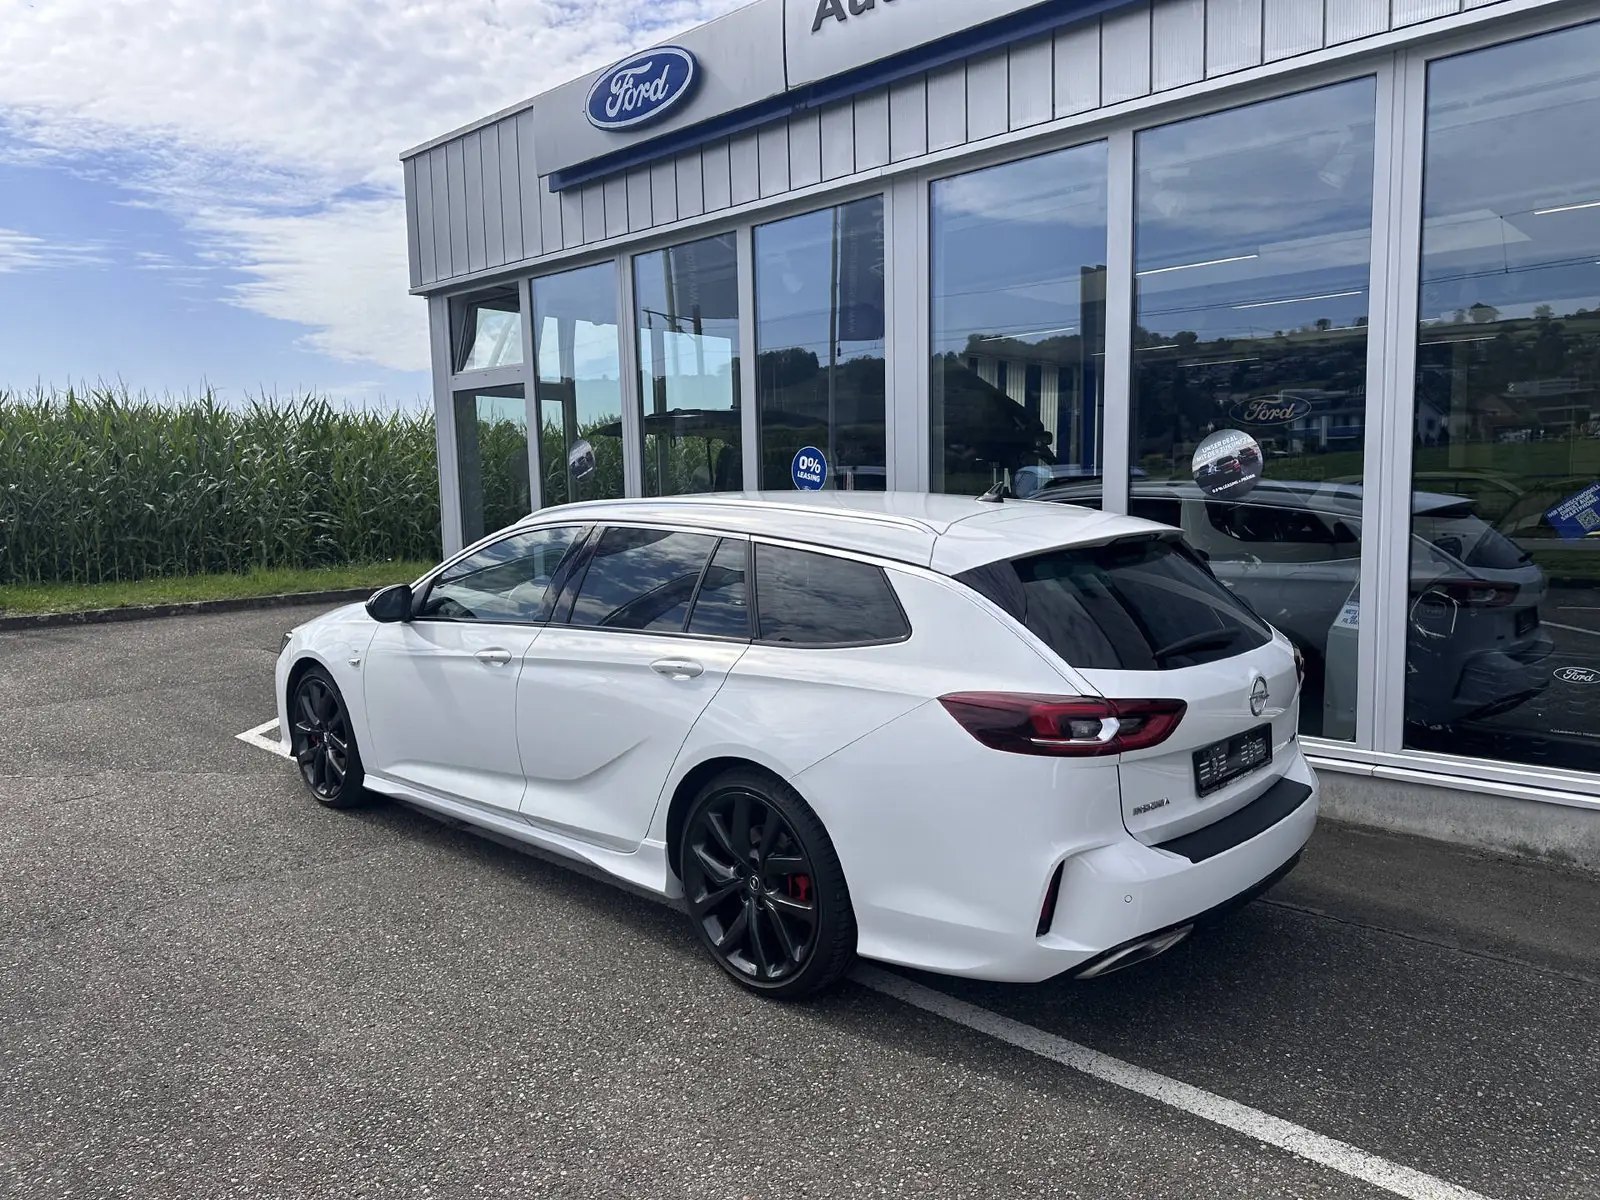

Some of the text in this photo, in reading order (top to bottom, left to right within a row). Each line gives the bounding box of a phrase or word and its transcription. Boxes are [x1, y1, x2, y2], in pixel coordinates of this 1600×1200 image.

[605, 61, 670, 118] Ford
[1243, 399, 1296, 421] Ford
[798, 455, 821, 474] 0%
[797, 470, 820, 483] LEASING
[1563, 668, 1595, 682] Ford
